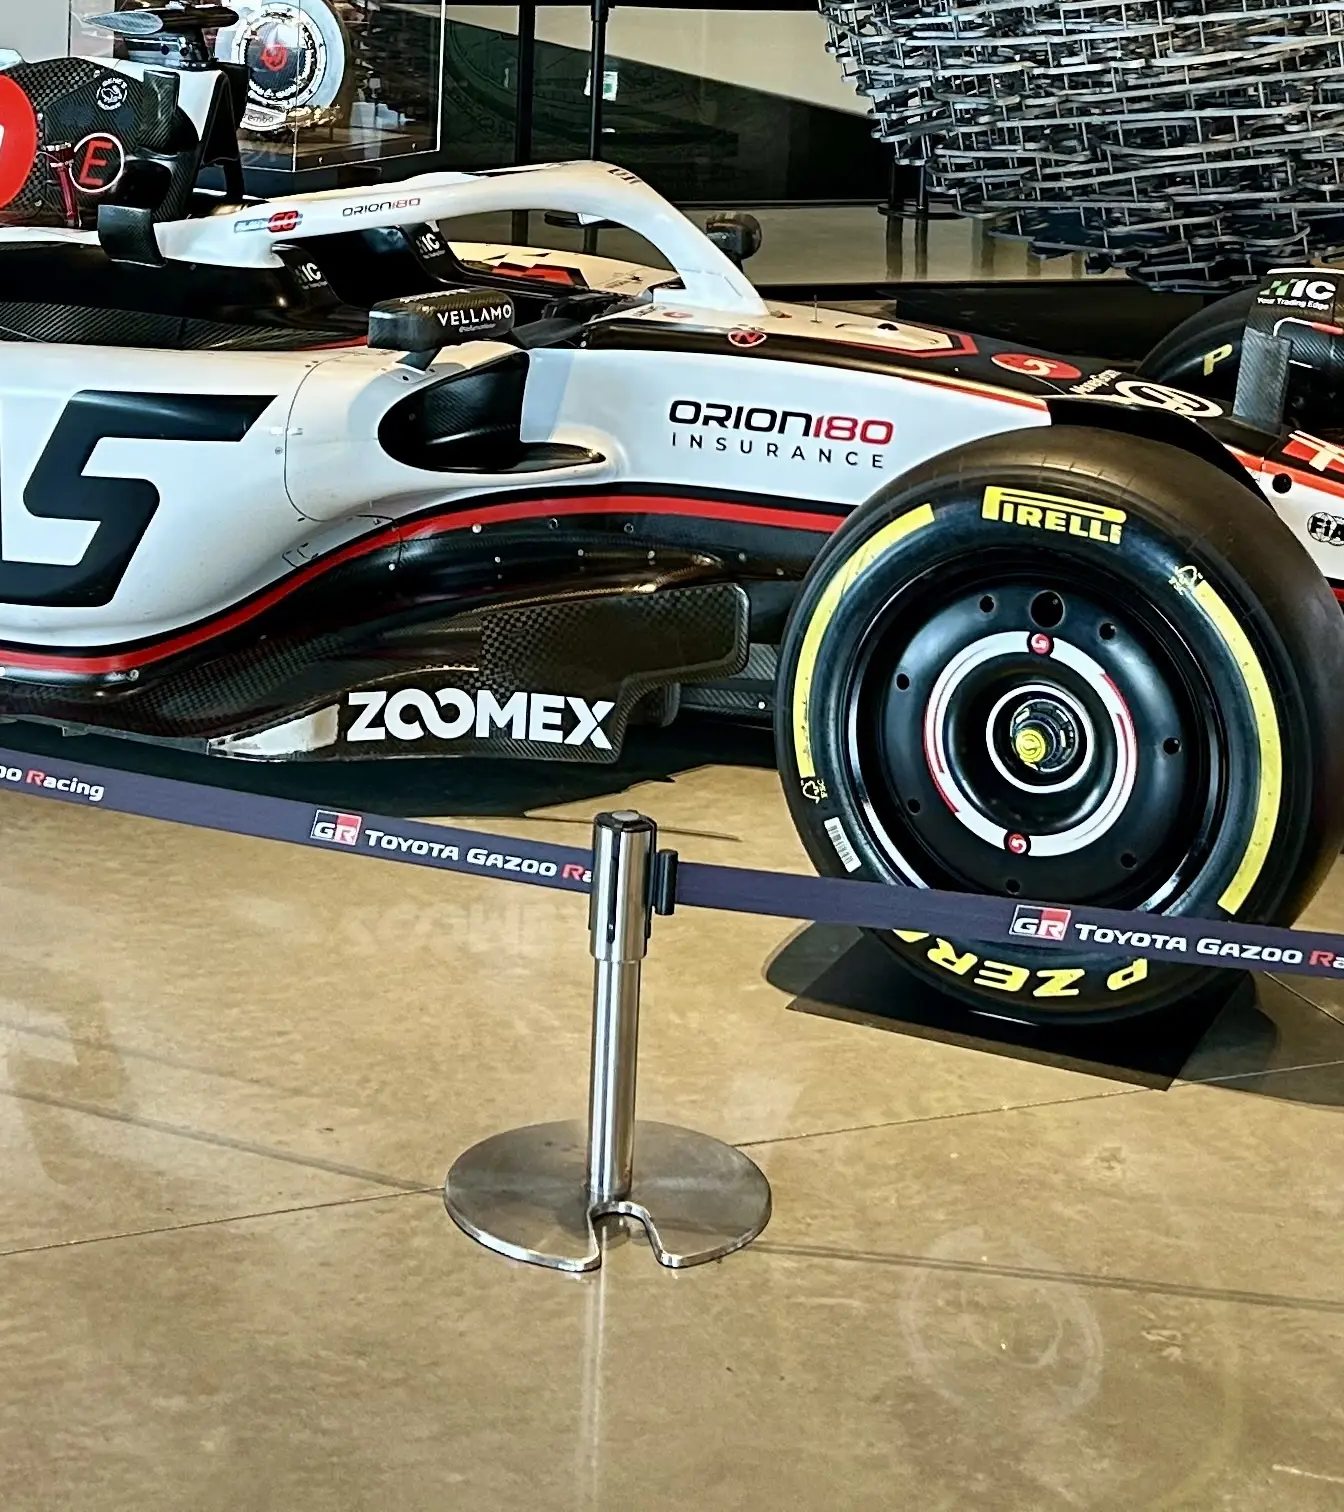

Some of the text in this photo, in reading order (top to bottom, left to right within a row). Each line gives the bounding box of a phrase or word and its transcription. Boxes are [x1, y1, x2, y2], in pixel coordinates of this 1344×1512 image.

[243, 113, 274, 124] rembo
[80, 140, 113, 186] E
[342, 197, 421, 217] ORION180
[437, 304, 512, 327] VELLAMO
[1277, 297, 1307, 308] Trading
[1307, 300, 1330, 311] Edge
[669, 399, 894, 446] ORION180
[671, 431, 885, 470] INSURANCE
[981, 485, 1127, 545] PIRELLI
[347, 687, 616, 752] ZOOMEX
[24, 768, 105, 802] Racing
[364, 829, 459, 861] TOYOTA
[466, 847, 557, 877] GAZOO
[891, 929, 1086, 998] ZER
[1074, 922, 1188, 952] TOYOTA
[1196, 937, 1304, 966] GAZOO
